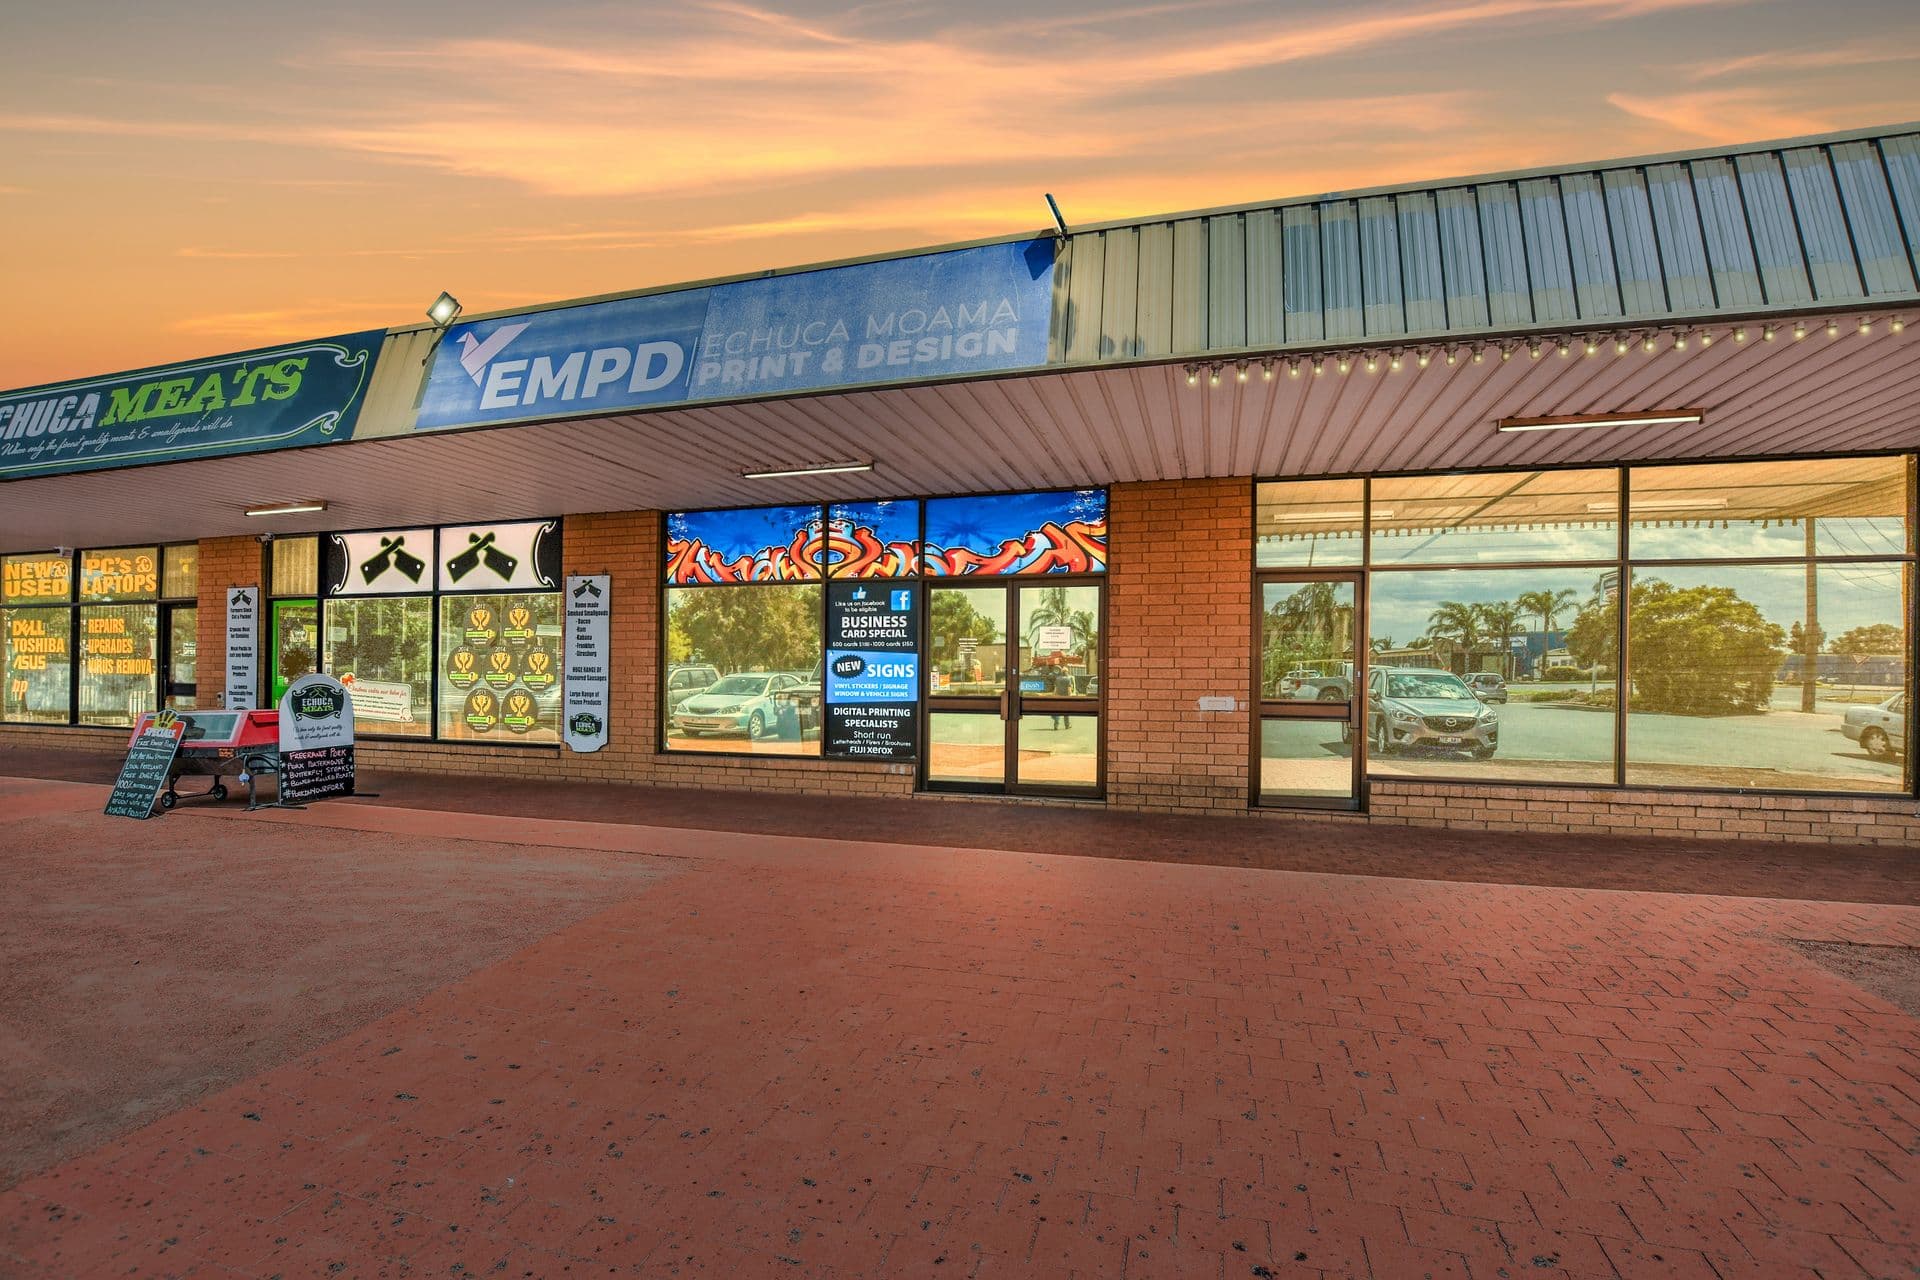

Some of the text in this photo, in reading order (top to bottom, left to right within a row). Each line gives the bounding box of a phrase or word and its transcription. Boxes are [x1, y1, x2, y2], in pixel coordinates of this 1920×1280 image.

[703, 298, 1018, 358] ECHUCA MOAMA
[698, 328, 1016, 385] PRINT & DESIGN
[479, 341, 684, 410] EMPD
[98, 358, 309, 427] MEATS
[27, 440, 45, 460] only
[46, 439, 57, 451] the
[54, 435, 86, 456] finest
[77, 432, 110, 453] quality
[111, 429, 135, 442] meats
[138, 426, 151, 440] &
[151, 422, 201, 444] smallgoods
[202, 417, 223, 431] will
[220, 415, 233, 428] do
[5, 562, 53, 579] NEW
[86, 556, 152, 575] PC's &
[5, 578, 69, 597] USED
[82, 575, 157, 595] LAPTOPS
[12, 620, 45, 636] DELL
[88, 619, 125, 633] REPAIRS
[841, 616, 908, 628] BUSINESS
[841, 629, 908, 638] CARD SPECIAL
[13, 638, 65, 653] TOSHIBA
[88, 639, 133, 653] UPGRADES
[14, 655, 46, 669] ASUS
[88, 659, 114, 674] VIRUS
[836, 661, 915, 678] NEW SIGNS
[302, 697, 333, 706] ECHUCA
[833, 707, 911, 717] DIGITAL PRINTING
[844, 719, 898, 729] SPECIALISTS
[853, 731, 874, 739] Short
[330, 747, 347, 758] PORK
[849, 746, 893, 755] FUJI xerox
[287, 762, 305, 770] PORK
[289, 764, 350, 779] BUTTERFLY STEAKS
